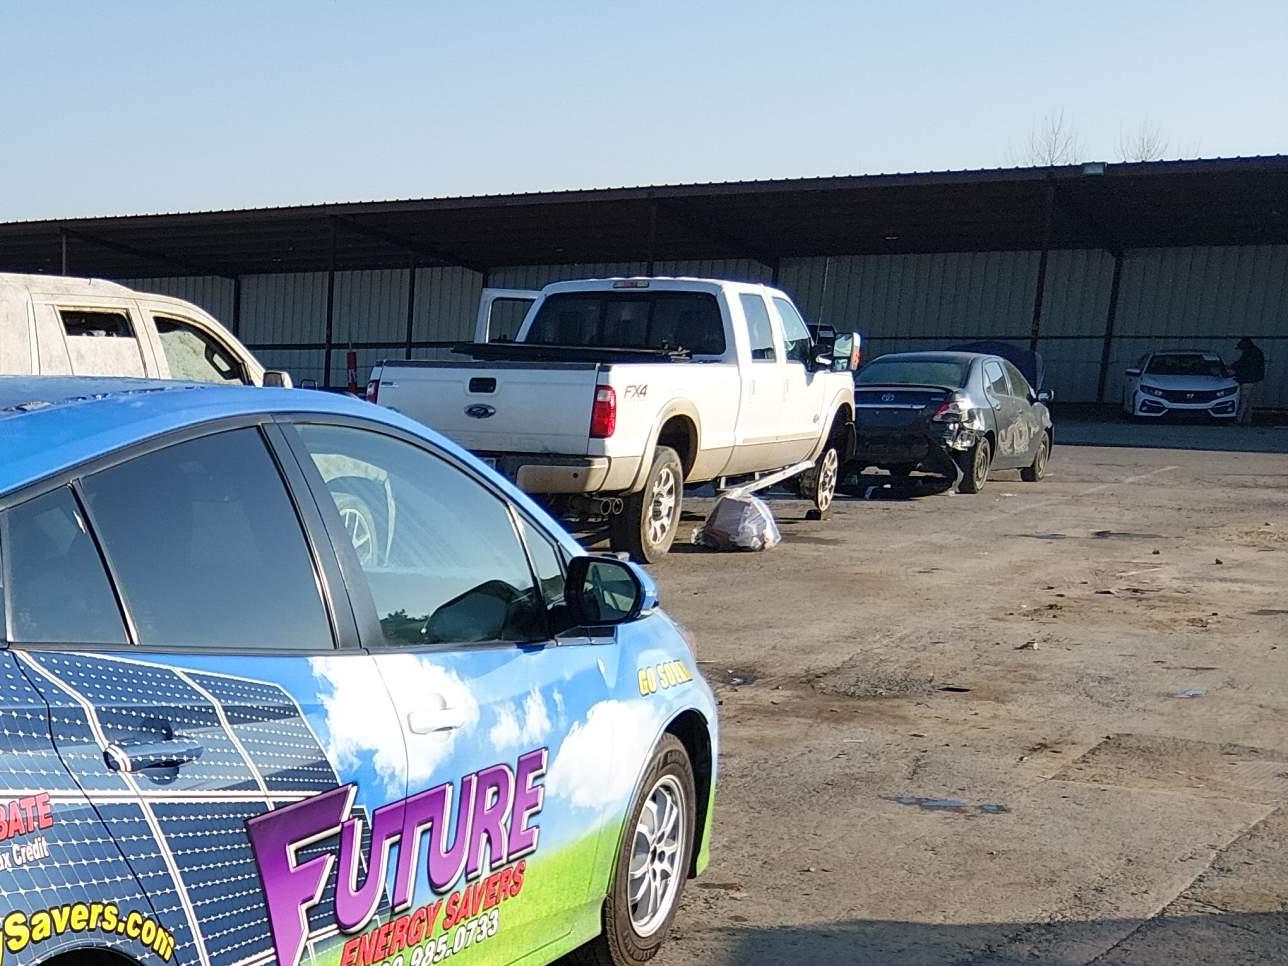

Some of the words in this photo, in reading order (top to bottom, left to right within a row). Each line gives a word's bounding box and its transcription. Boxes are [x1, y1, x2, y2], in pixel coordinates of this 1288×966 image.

[623, 384, 648, 399] FX4
[637, 666, 656, 696] GO
[12, 837, 49, 865] Credit
[442, 859, 526, 930] SAVERS
